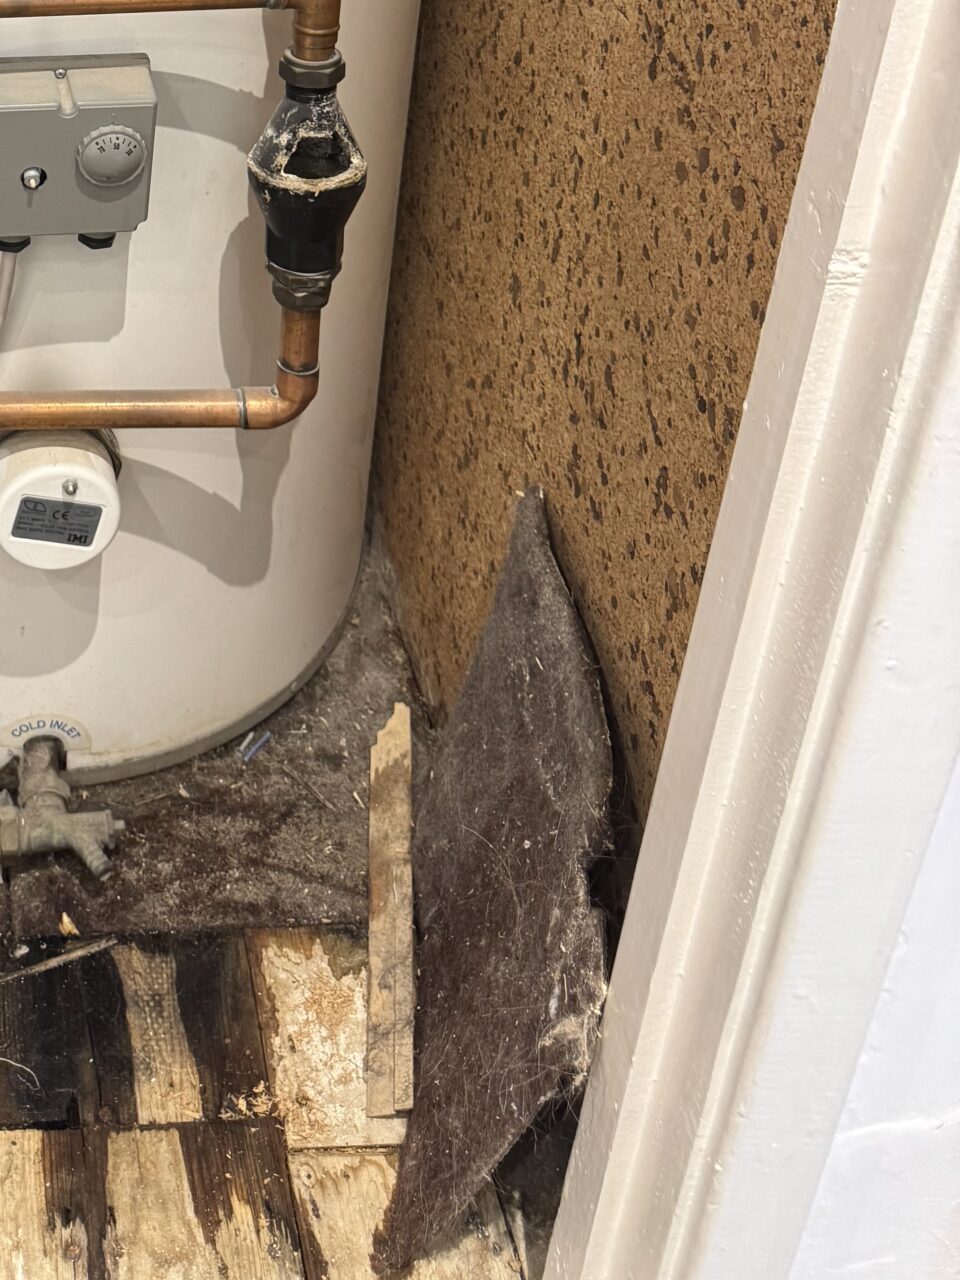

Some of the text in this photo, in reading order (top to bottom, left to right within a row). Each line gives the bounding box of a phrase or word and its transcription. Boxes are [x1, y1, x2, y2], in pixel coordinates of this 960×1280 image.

[98, 145, 106, 154] 70
[113, 143, 121, 151] 50
[67, 534, 88, 544] IMI
[11, 720, 81, 738] COLD INLET
